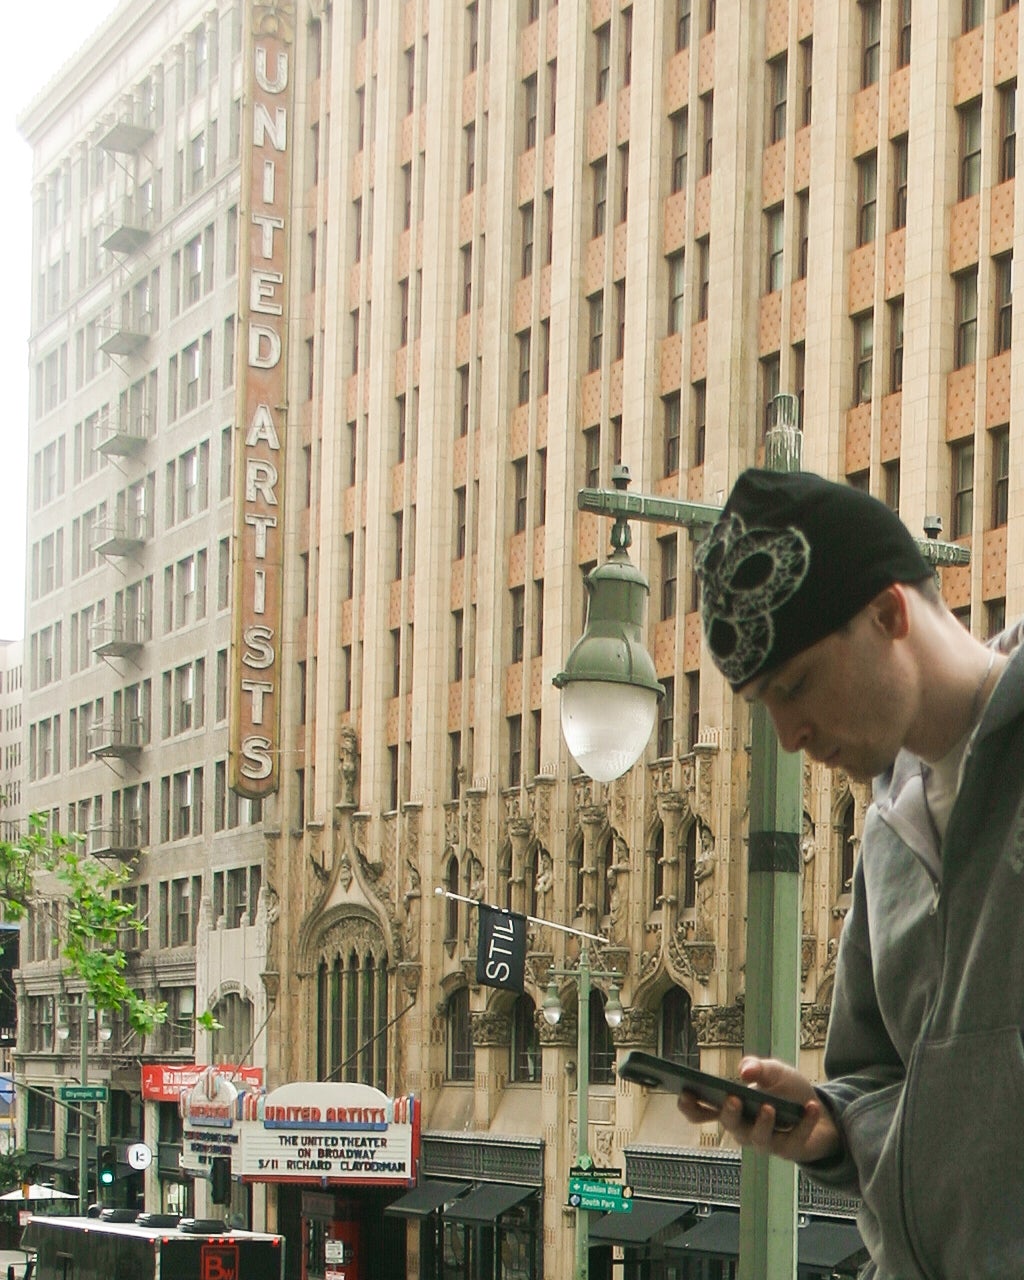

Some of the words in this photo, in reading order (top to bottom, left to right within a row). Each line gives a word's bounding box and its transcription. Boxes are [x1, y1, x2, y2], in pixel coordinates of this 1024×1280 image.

[248, 47, 288, 368] UNITED
[240, 403, 280, 781] ARTISTS
[65, 1090, 94, 1099] Olympic
[265, 1106, 321, 1122] UNITED
[326, 1107, 386, 1123] ARTISTS
[279, 1136, 298, 1146] THE
[301, 1136, 338, 1147] UNITED
[340, 1137, 388, 1148] THEATER
[298, 1149, 311, 1158] ON
[318, 1150, 376, 1160] BROADWAY
[286, 1160, 332, 1171] RICHARD
[340, 1161, 406, 1173] CLAYDERMAN
[582, 1184, 606, 1194] Fashion
[607, 1187, 620, 1195] Dist
[581, 1197, 600, 1206] South
[601, 1199, 615, 1208] Park
